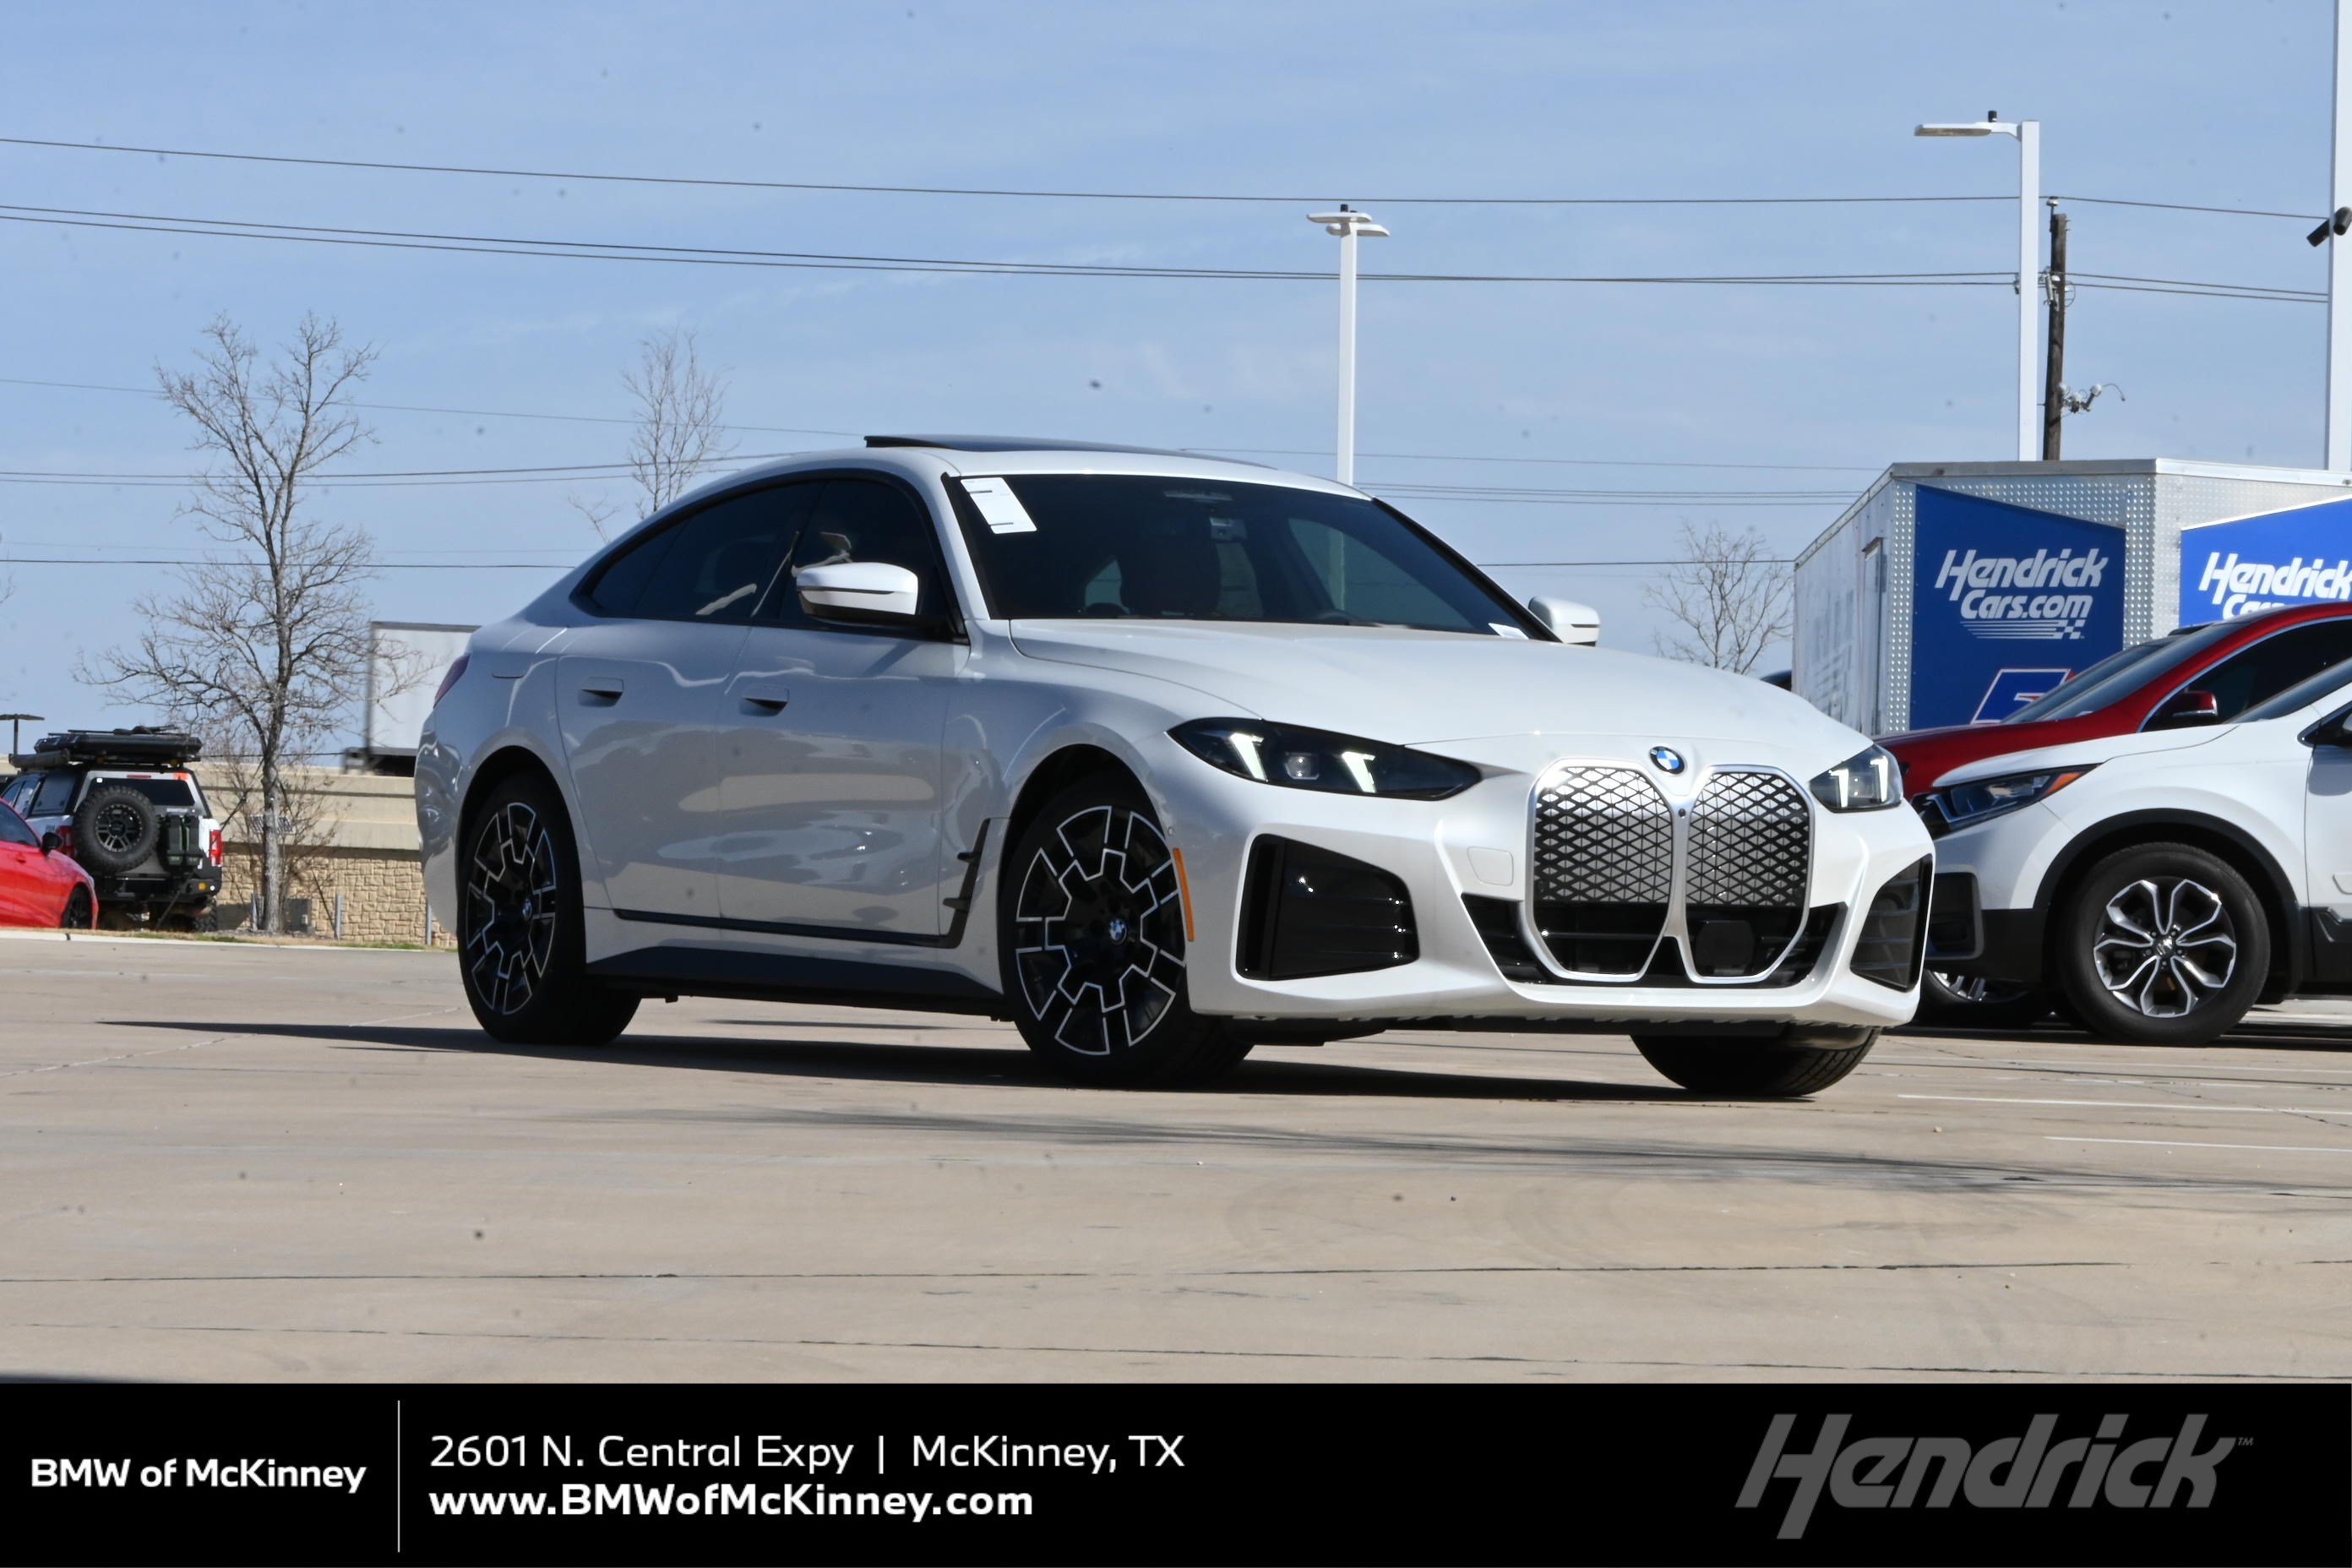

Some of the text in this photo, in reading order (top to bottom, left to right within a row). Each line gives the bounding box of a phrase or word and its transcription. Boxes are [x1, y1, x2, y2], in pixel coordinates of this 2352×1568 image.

[1935, 548, 2109, 601] Hendrick
[2198, 552, 2352, 605] Hendrick
[1960, 590, 2093, 619] Cars.com
